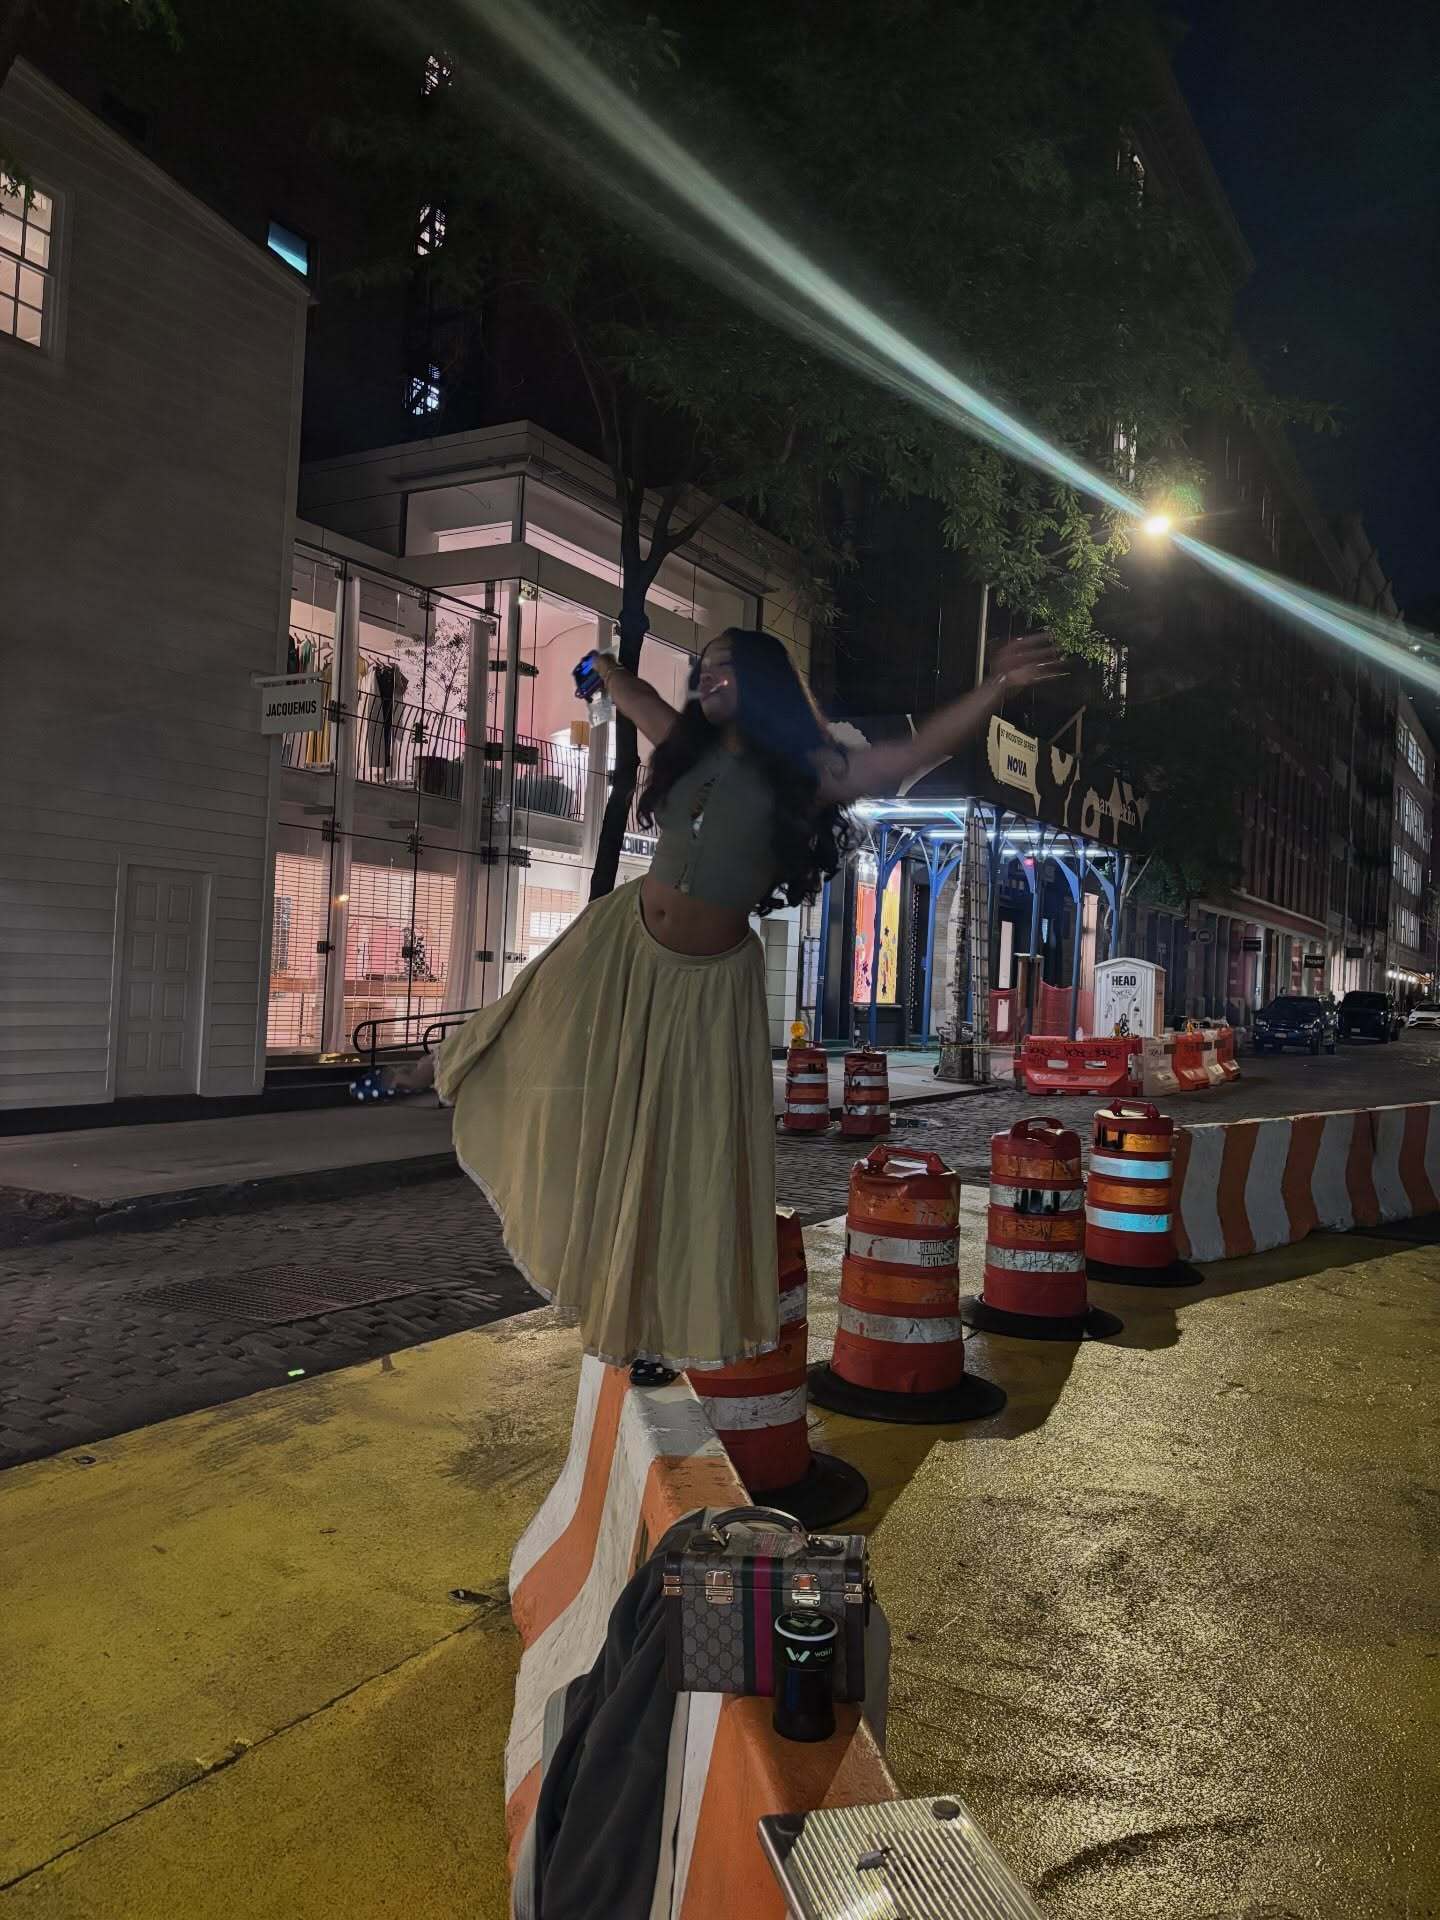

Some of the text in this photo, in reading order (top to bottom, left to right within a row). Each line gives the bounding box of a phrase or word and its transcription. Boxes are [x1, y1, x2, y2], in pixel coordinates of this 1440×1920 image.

[266, 701, 317, 717] JACQUEMUS
[1007, 754, 1027, 777] NOVA
[1112, 975, 1136, 986] HEAD
